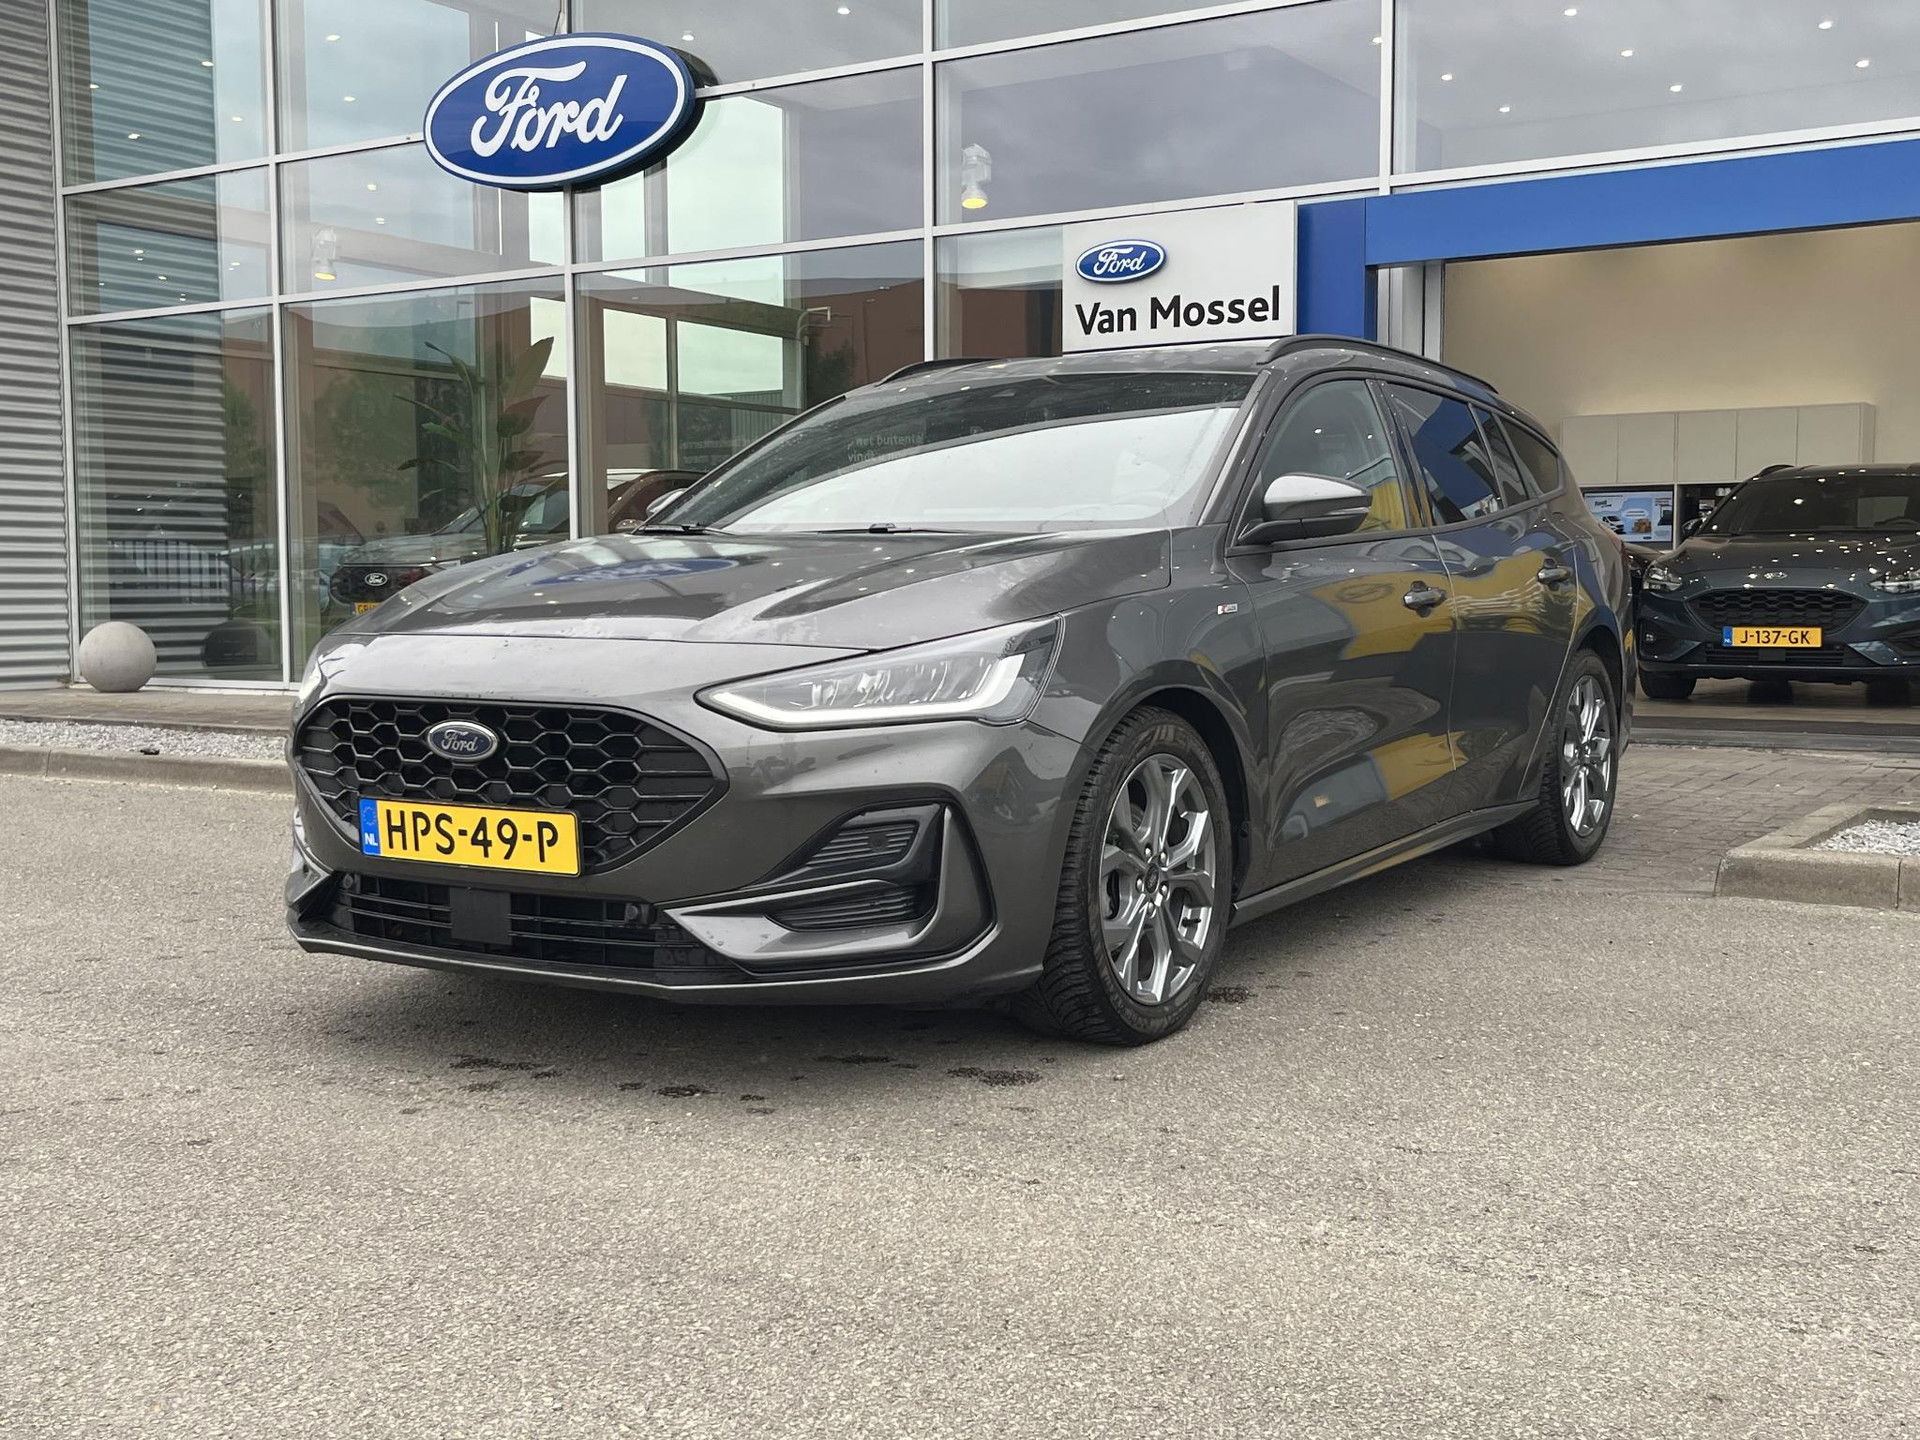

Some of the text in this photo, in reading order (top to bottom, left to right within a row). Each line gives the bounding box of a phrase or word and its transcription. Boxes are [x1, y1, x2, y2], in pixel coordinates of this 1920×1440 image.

[470, 60, 628, 158] Ford
[1093, 247, 1146, 276] Ford
[1075, 285, 1280, 336] Van Mossel
[1740, 630, 1810, 645] J-137-GK
[441, 729, 479, 752] Ford
[364, 808, 559, 863] NL HPS-49-P
